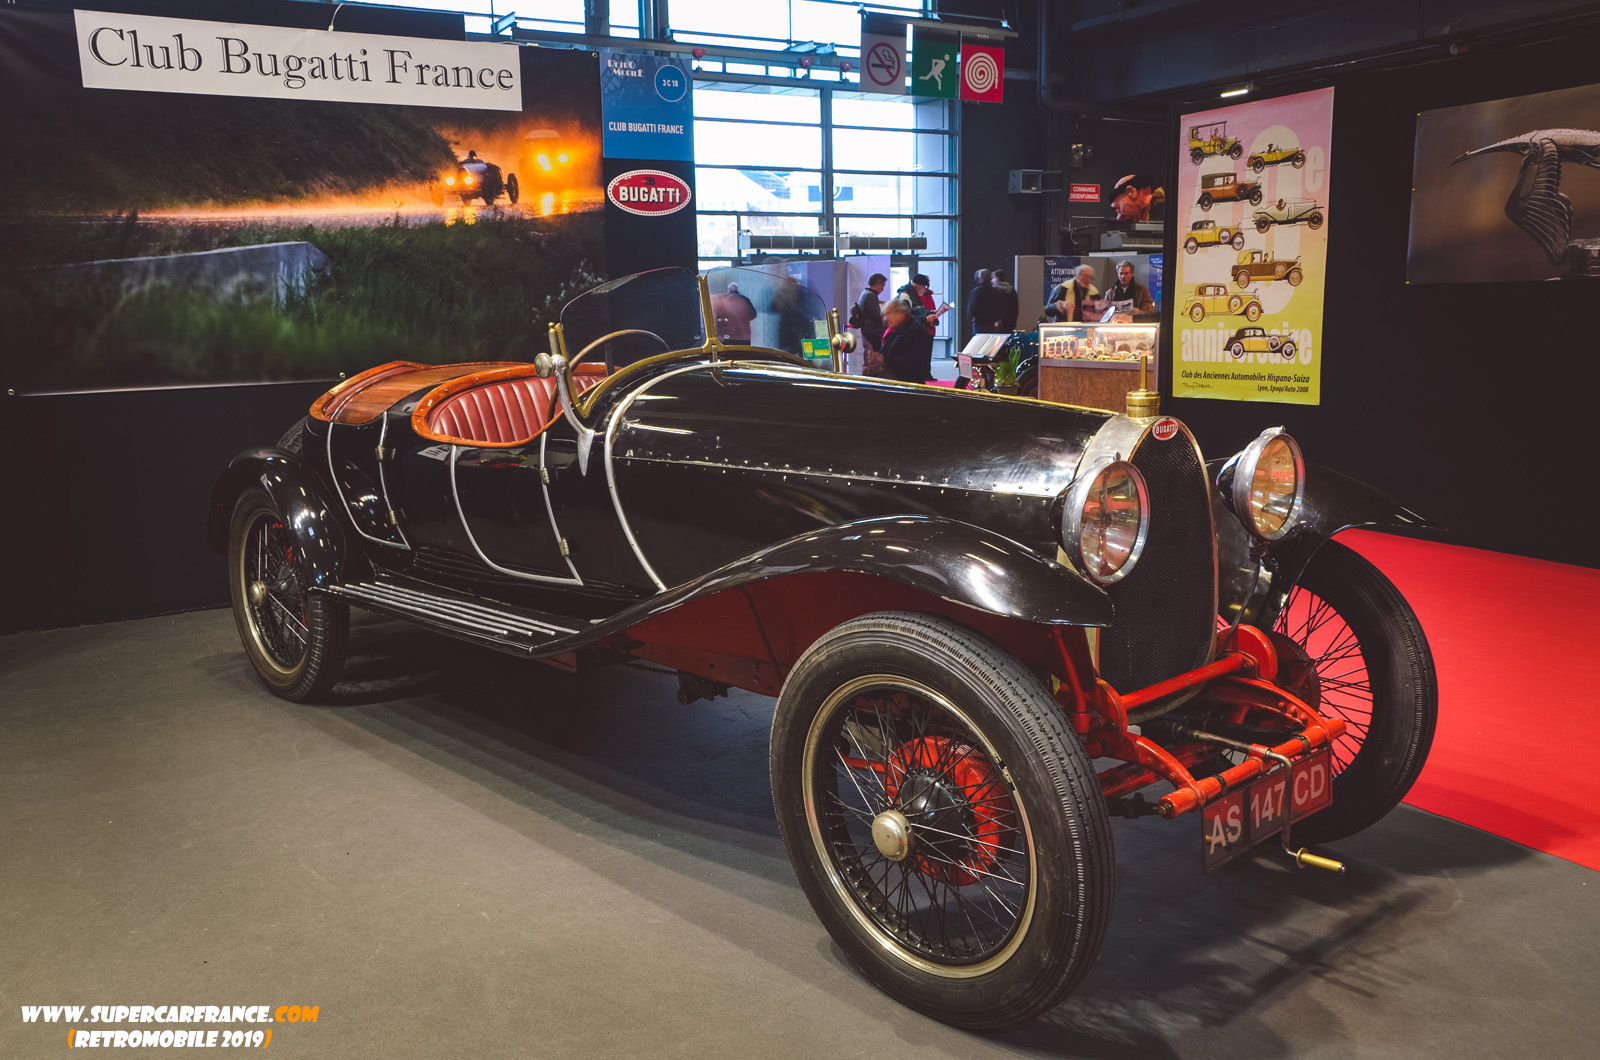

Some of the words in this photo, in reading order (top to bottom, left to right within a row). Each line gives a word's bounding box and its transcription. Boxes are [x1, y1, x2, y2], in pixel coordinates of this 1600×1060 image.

[88, 27, 202, 71] Club
[216, 36, 372, 89] Bugatti
[383, 49, 513, 90] France
[608, 121, 627, 132] CLUB
[628, 122, 657, 133] BUGATTI
[658, 124, 684, 134] FRANCE
[619, 186, 681, 203] BUGATTI
[1181, 370, 1193, 378] Club
[1193, 371, 1203, 379] des
[1203, 371, 1231, 380] Anciennes
[1231, 372, 1266, 381] Automobiles
[1267, 373, 1310, 384] Hispano-Suiza
[1257, 384, 1269, 392] Lyon,
[1210, 805, 1241, 855] AS
[1251, 781, 1286, 829] 147
[1294, 764, 1325, 805] CD
